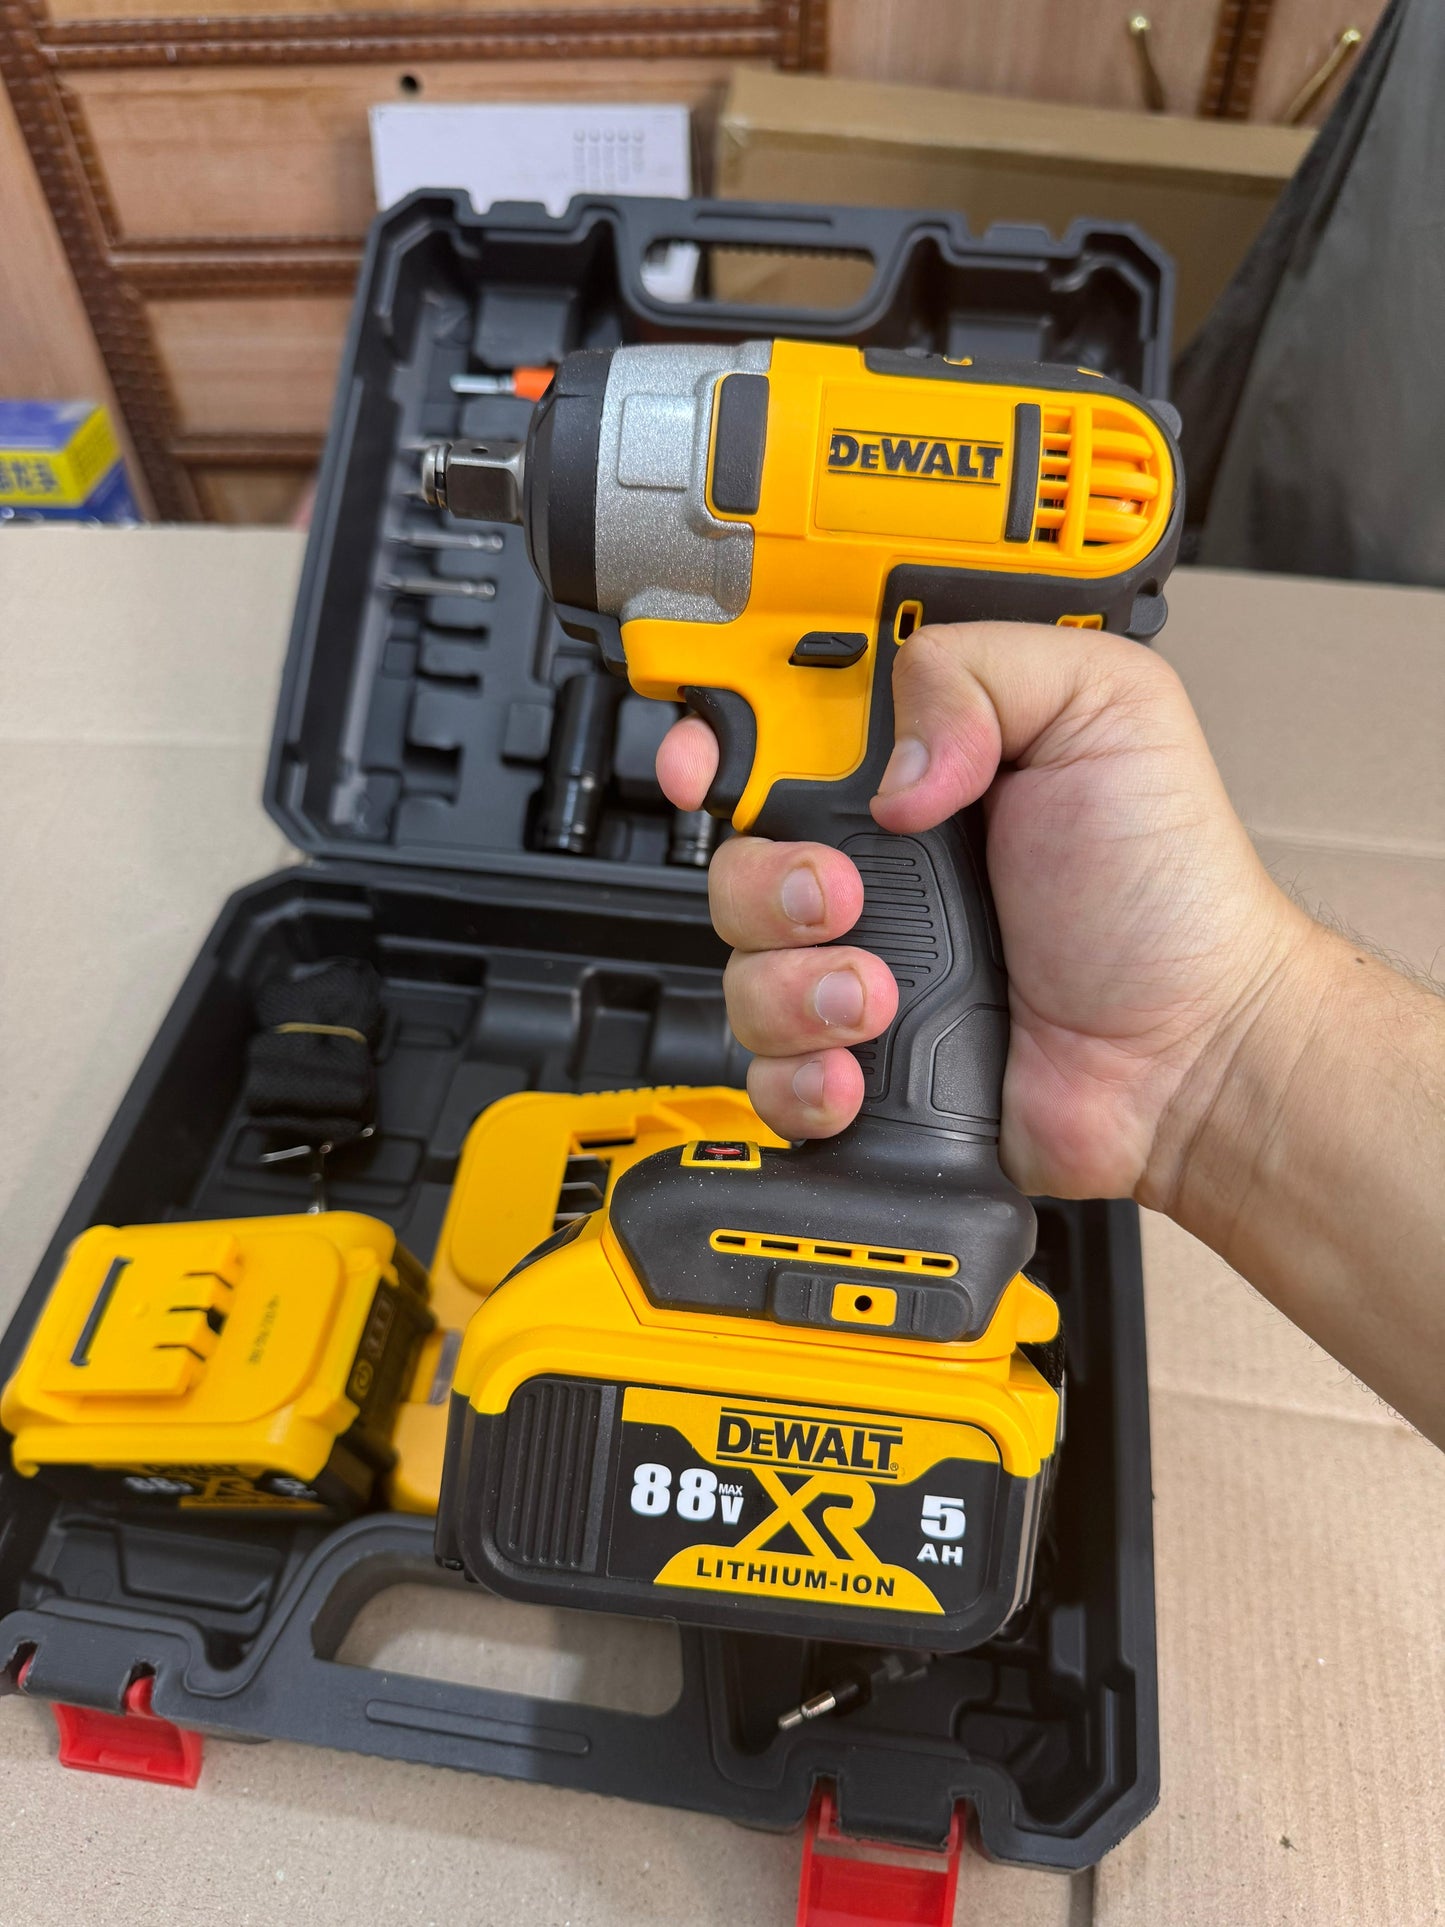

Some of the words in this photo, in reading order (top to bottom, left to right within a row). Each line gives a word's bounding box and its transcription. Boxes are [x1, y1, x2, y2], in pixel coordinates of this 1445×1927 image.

[828, 434, 1003, 479] DEWALT
[718, 1483, 744, 1496] MAX
[734, 1466, 882, 1564] XR
[920, 1494, 967, 1540] 5
[916, 1543, 964, 1567] AH
[696, 1557, 896, 1597] LITHIUM-ION
